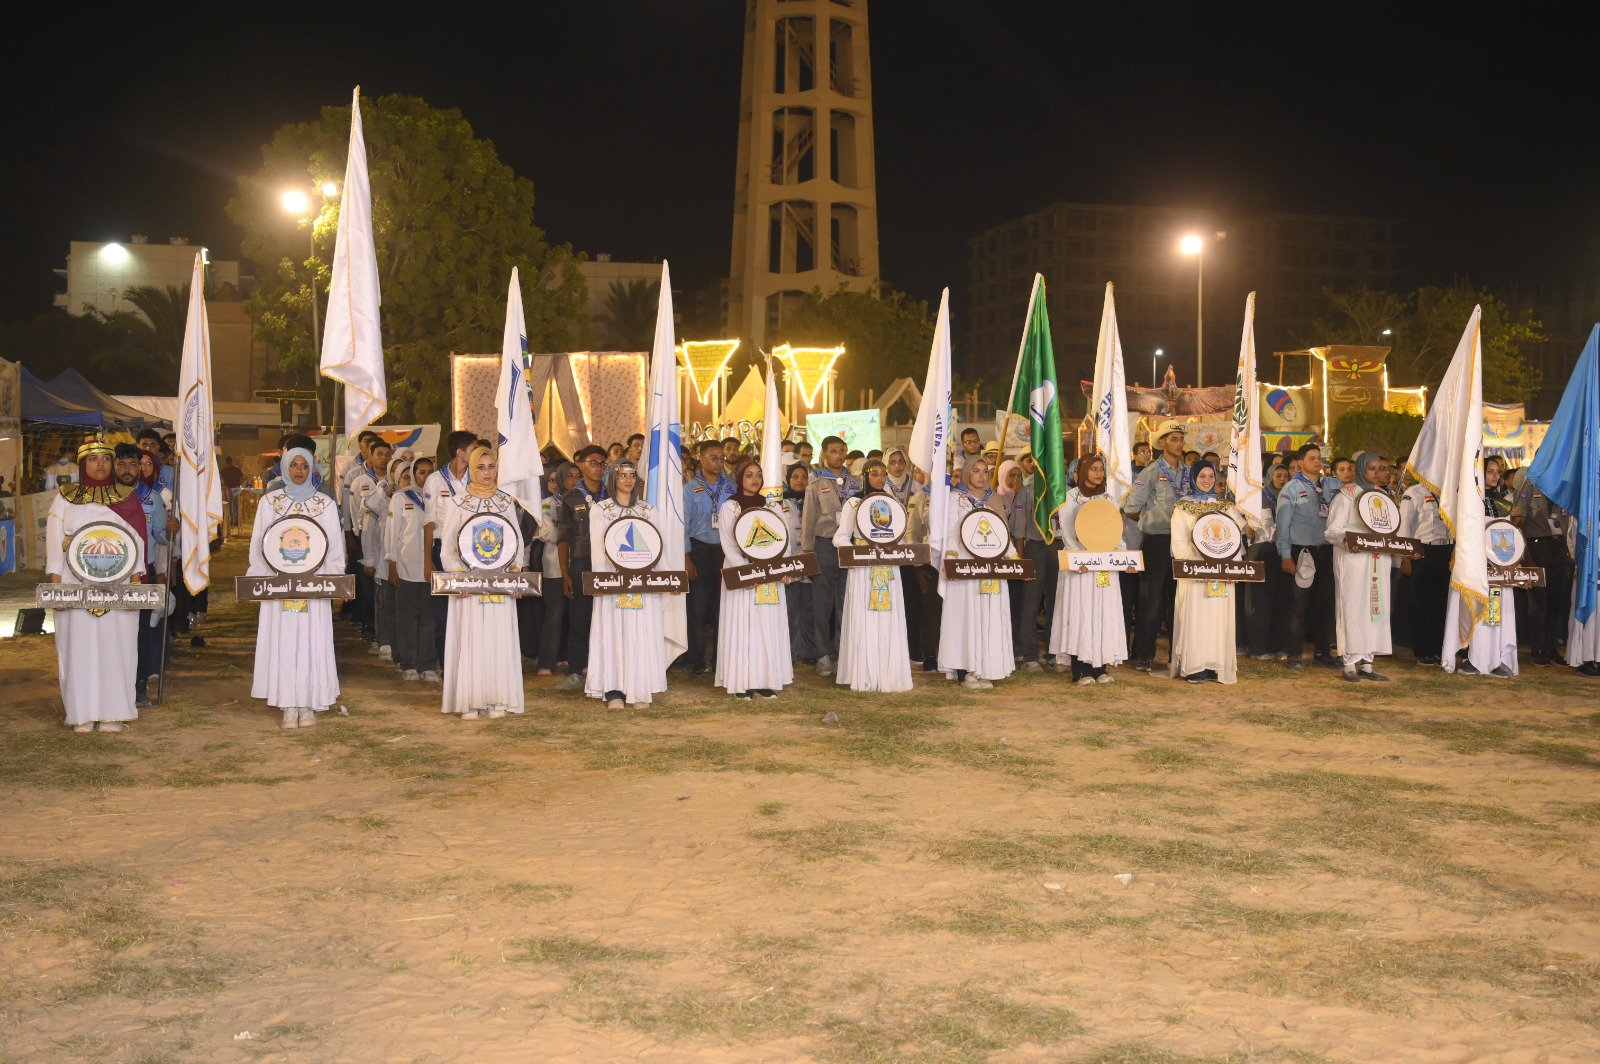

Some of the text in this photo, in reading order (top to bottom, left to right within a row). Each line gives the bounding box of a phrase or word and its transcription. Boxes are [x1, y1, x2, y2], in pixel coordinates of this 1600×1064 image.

[1387, 538, 1414, 552] جامعة
[852, 548, 915, 561] جامعة قنا
[1074, 554, 1138, 567] جامعة العاصمة
[737, 559, 805, 581] جامعة بنها
[955, 563, 1024, 576] جامعة المنوفية
[1182, 561, 1256, 577] جامعة المنصورة
[1513, 568, 1539, 582] جامعة
[252, 579, 336, 596] جامعة أسوان
[444, 576, 529, 591] جامعة دمنهور
[593, 574, 681, 589] جامعة كفر الشيخ
[41, 589, 159, 604] جامعة مدينة السادات
